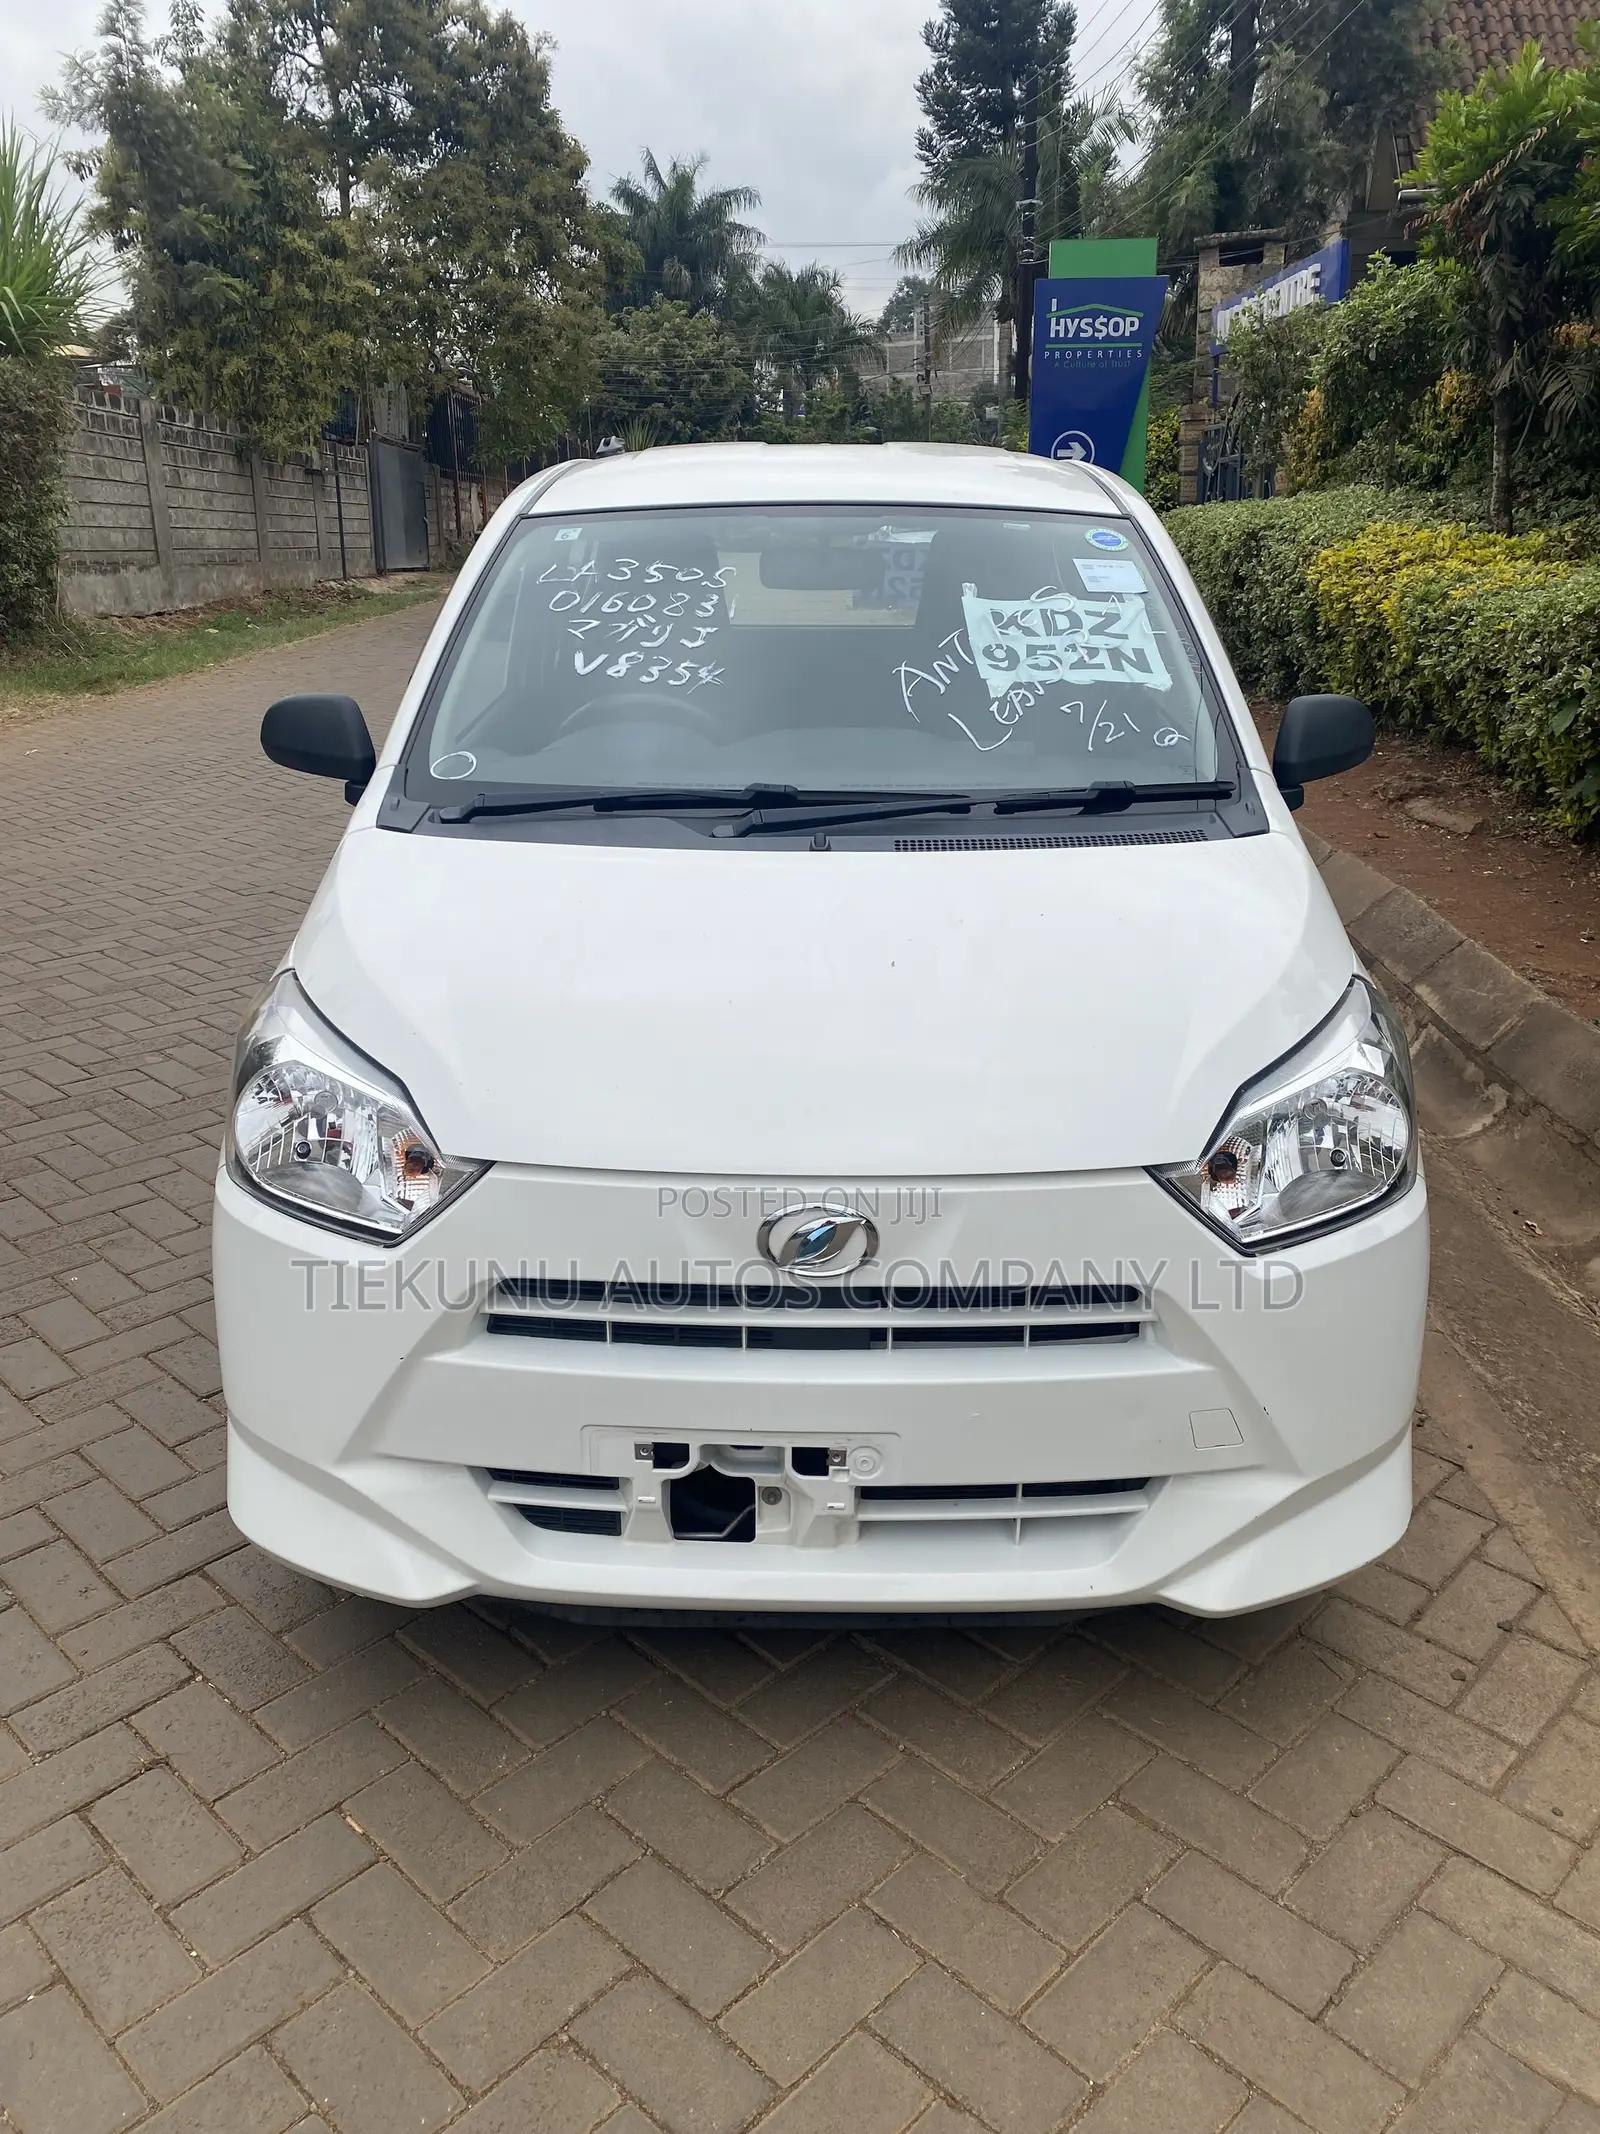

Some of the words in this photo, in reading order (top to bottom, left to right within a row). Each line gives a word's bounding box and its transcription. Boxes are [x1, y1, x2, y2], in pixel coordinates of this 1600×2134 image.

[1044, 350, 1143, 359] PROPERTIES
[1063, 360, 1096, 368] Culture
[1111, 360, 1131, 368] Trust
[989, 608, 1129, 640] KDZ
[981, 642, 1155, 675] 952N
